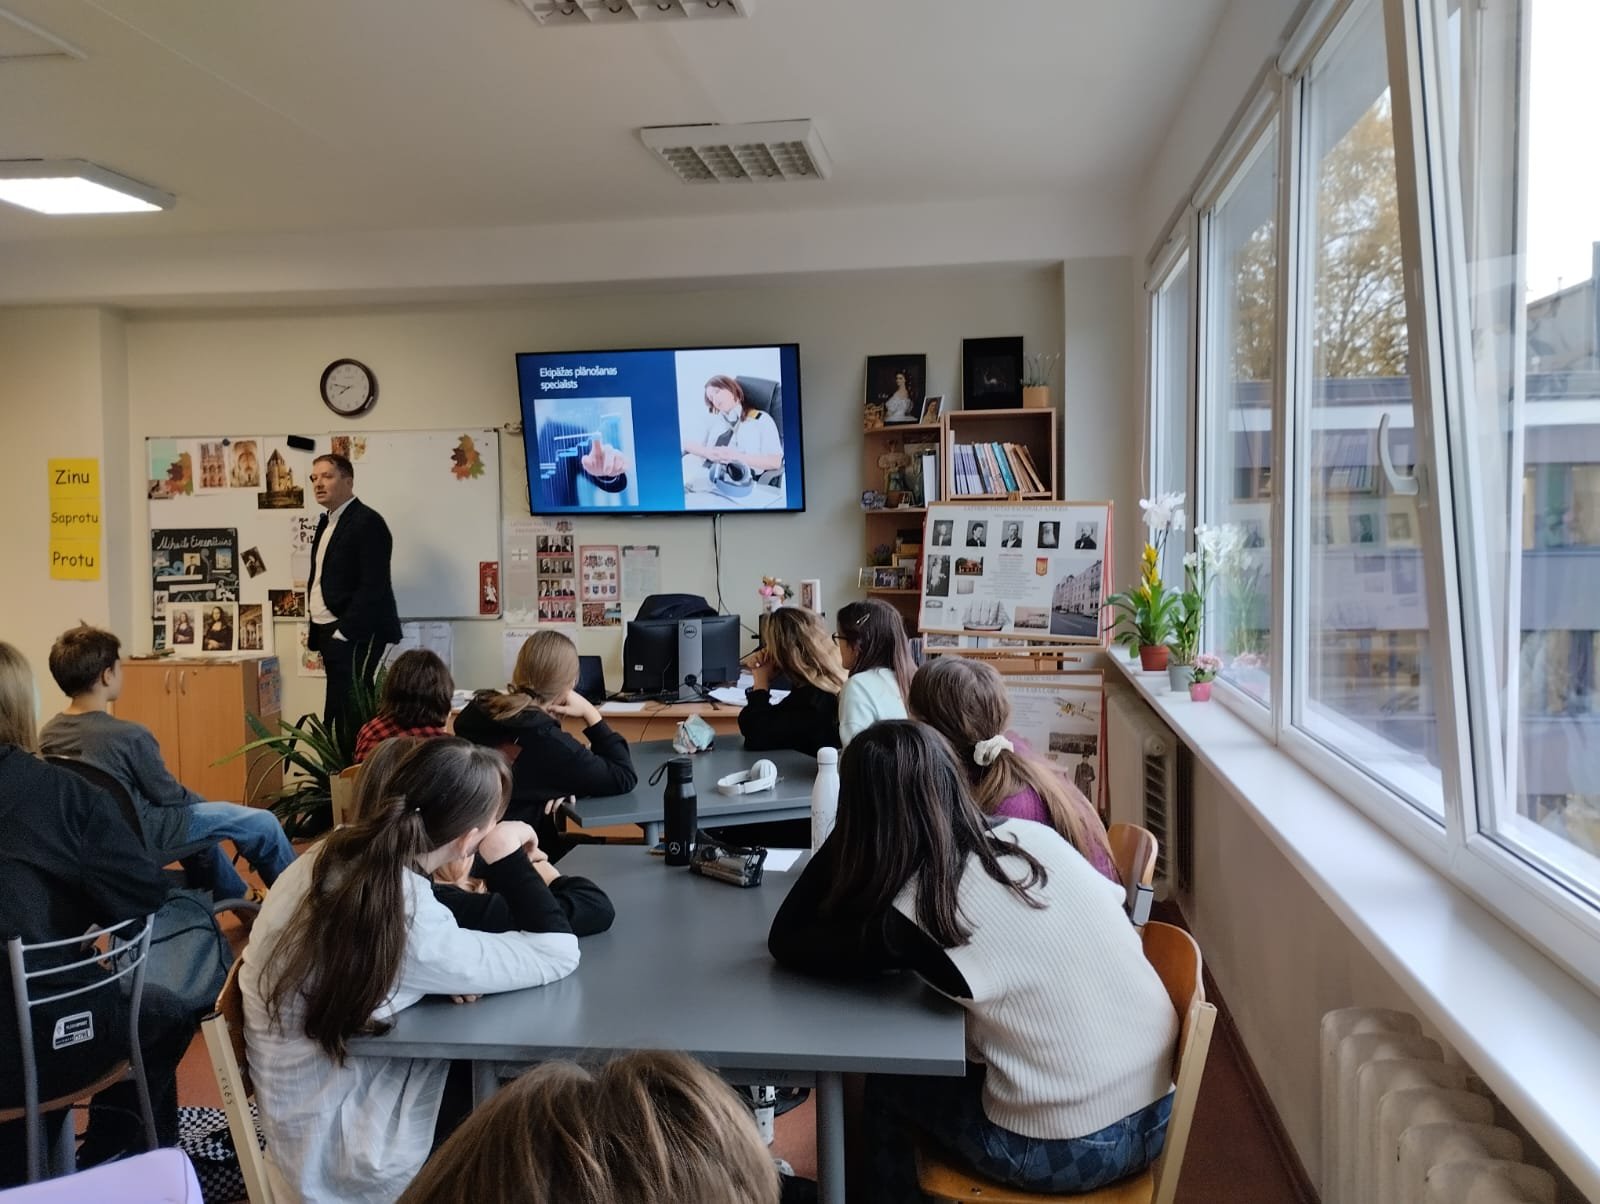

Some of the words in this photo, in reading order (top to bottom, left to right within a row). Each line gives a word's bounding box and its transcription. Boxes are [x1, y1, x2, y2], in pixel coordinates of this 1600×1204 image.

[540, 379, 578, 391] specialists
[55, 469, 90, 485] Zinu
[51, 511, 99, 526] Saprotu
[52, 551, 94, 567] Protu
